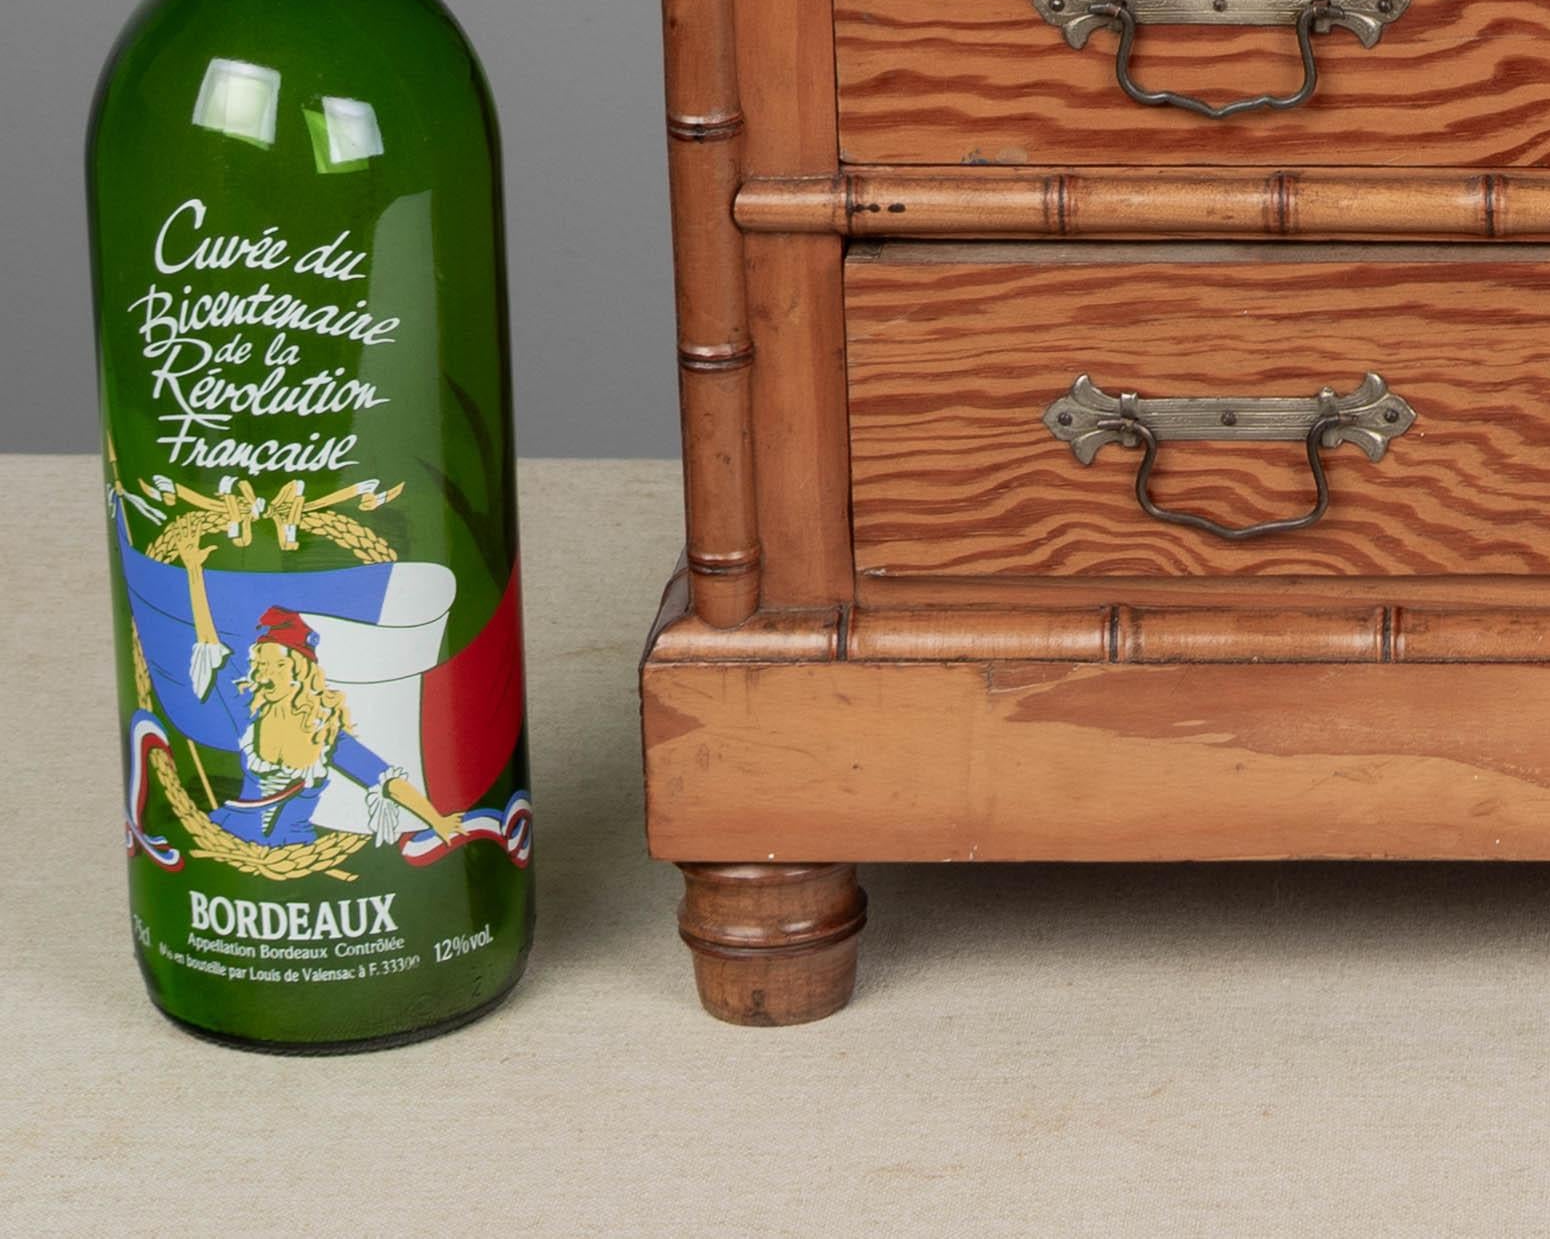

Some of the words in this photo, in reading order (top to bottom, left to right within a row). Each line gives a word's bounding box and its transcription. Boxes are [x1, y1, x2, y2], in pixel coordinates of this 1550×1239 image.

[154, 198, 291, 275] Cuvée
[294, 230, 367, 281] du
[127, 283, 401, 357] Bicentenaire
[214, 332, 253, 365] de
[264, 332, 301, 367] la
[151, 338, 392, 431] Révolution
[156, 414, 360, 476] Française
[188, 889, 399, 941] BORDEAUX
[187, 931, 257, 959] Appellation
[260, 943, 329, 960] Bordeaux
[334, 936, 405, 958] Contrôlée
[228, 966, 247, 981] par
[250, 966, 282, 982] Louis
[283, 968, 300, 982] de
[302, 967, 357, 982] Valensac
[358, 963, 366, 979] à
